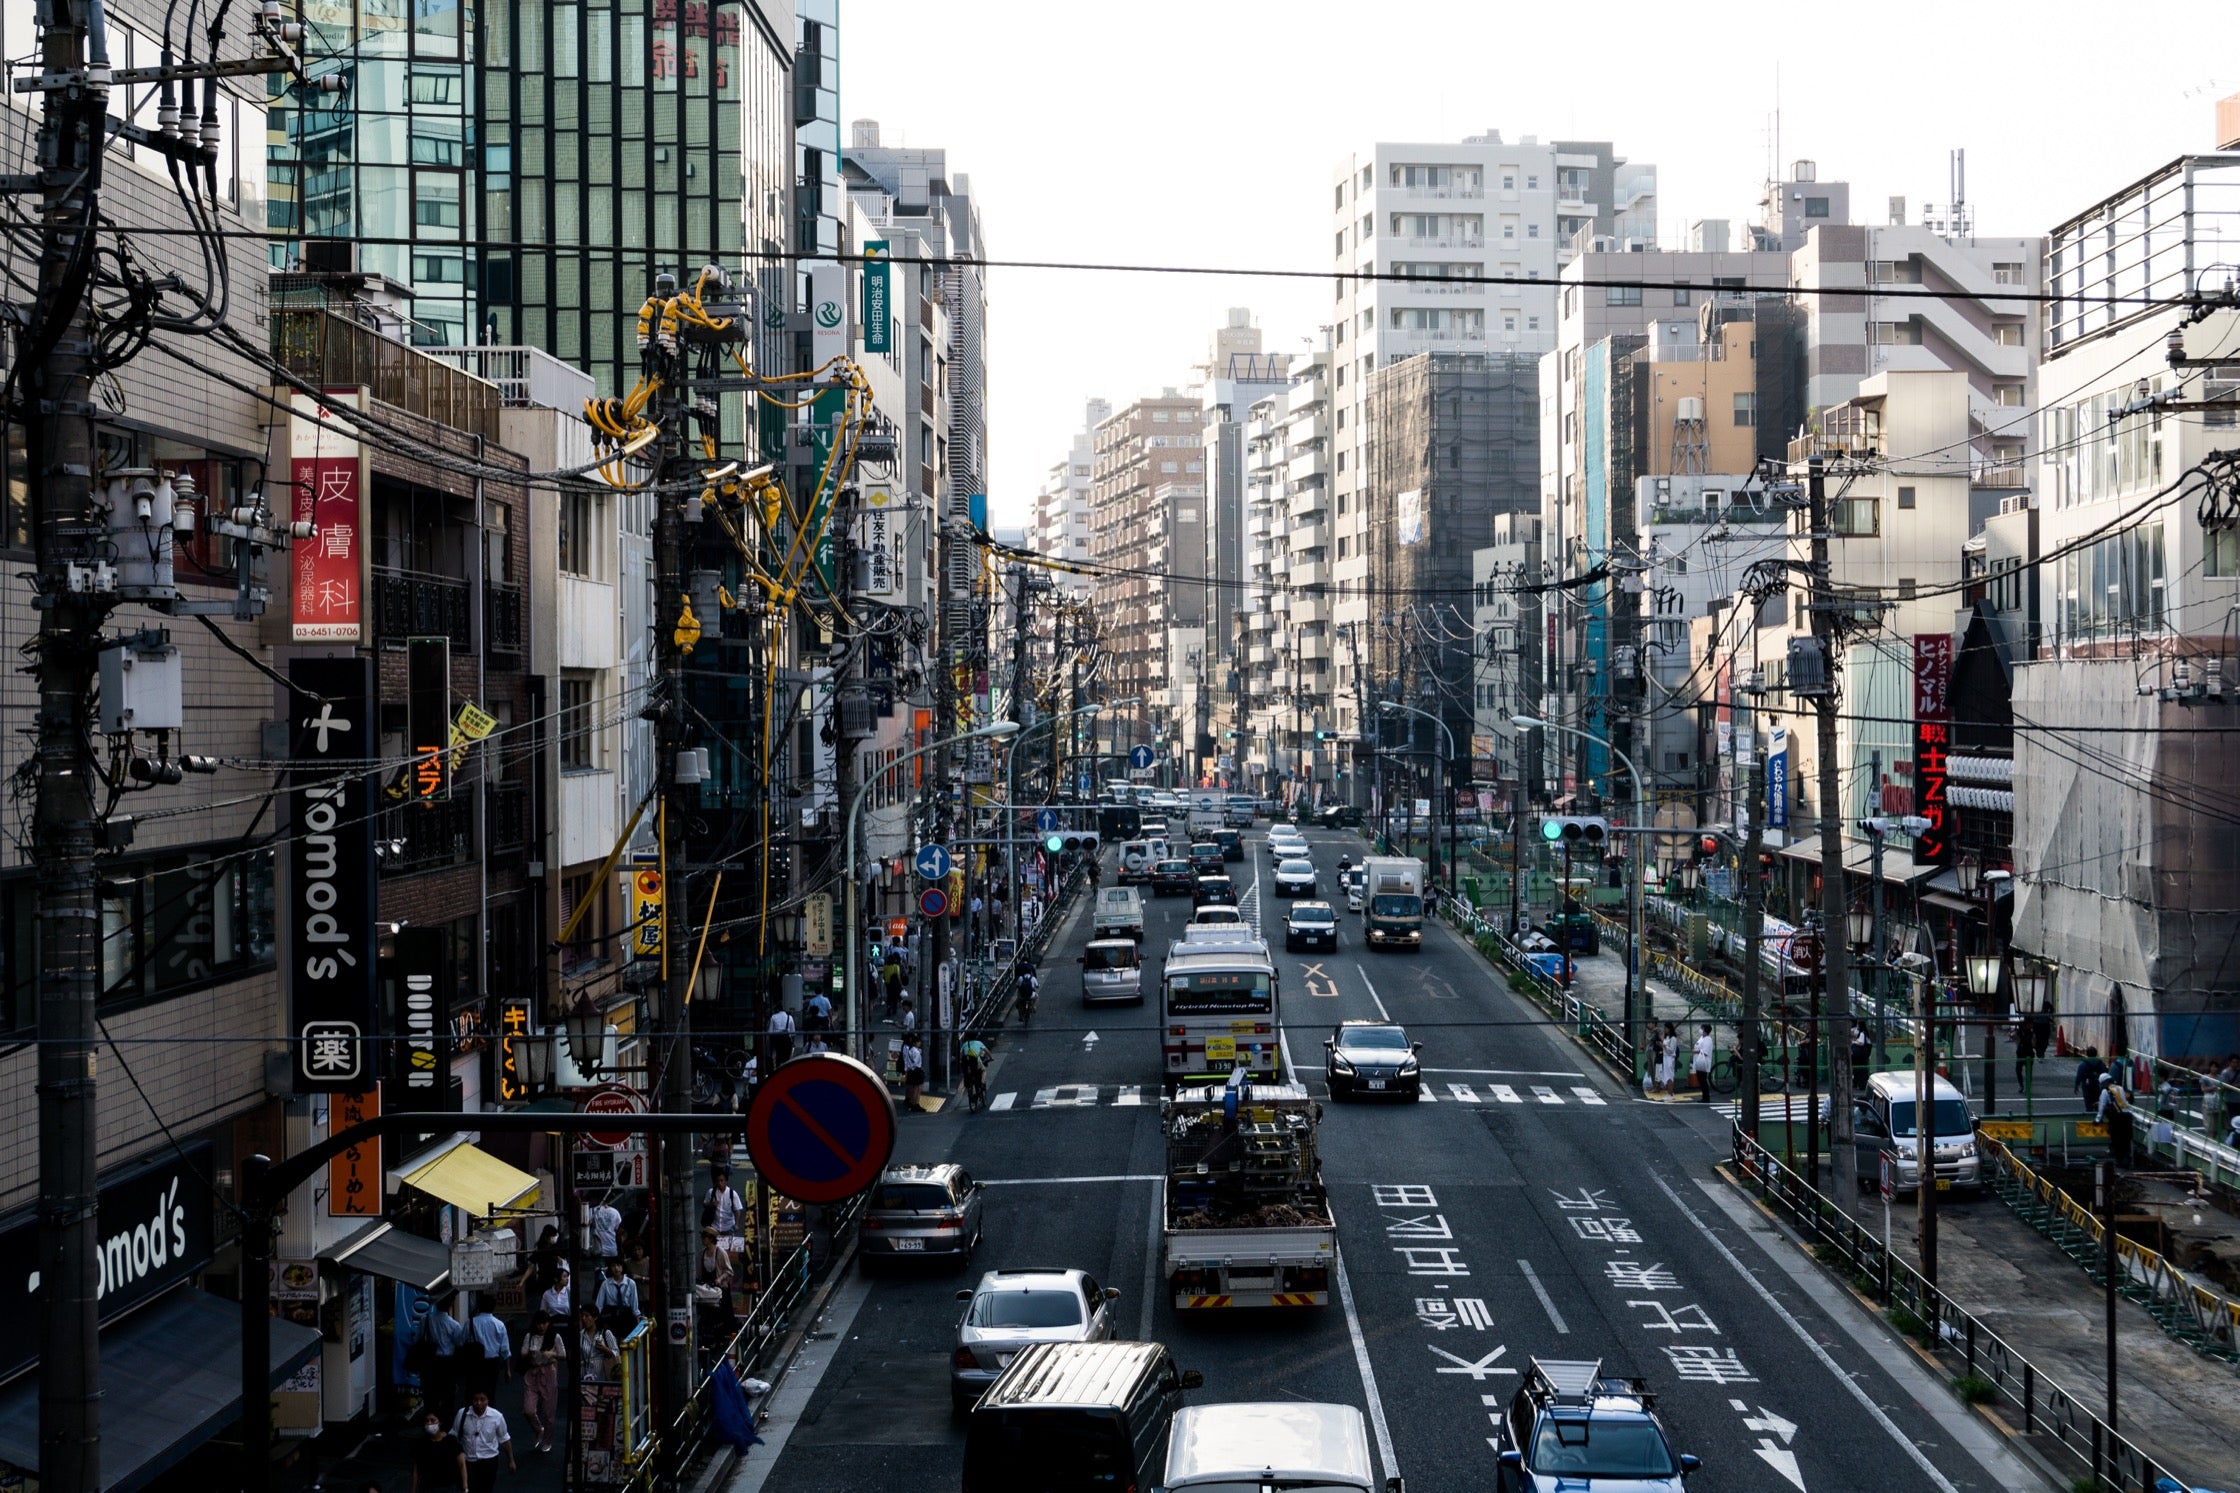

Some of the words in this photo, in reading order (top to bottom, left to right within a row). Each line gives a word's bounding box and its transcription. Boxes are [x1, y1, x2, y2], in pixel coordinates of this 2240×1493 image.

[871, 275, 884, 345] 明治安田生命
[317, 465, 355, 616] 皮膚科
[873, 511, 886, 588] 住友不動産販売
[296, 628, 359, 637] 03-6451-0706
[1919, 640, 1937, 714] ヒノマル
[305, 781, 357, 980] Tomod's
[406, 974, 438, 1088] DOUTOR
[1209, 1002, 1247, 1010] Nonstop
[312, 1030, 352, 1071] 薬
